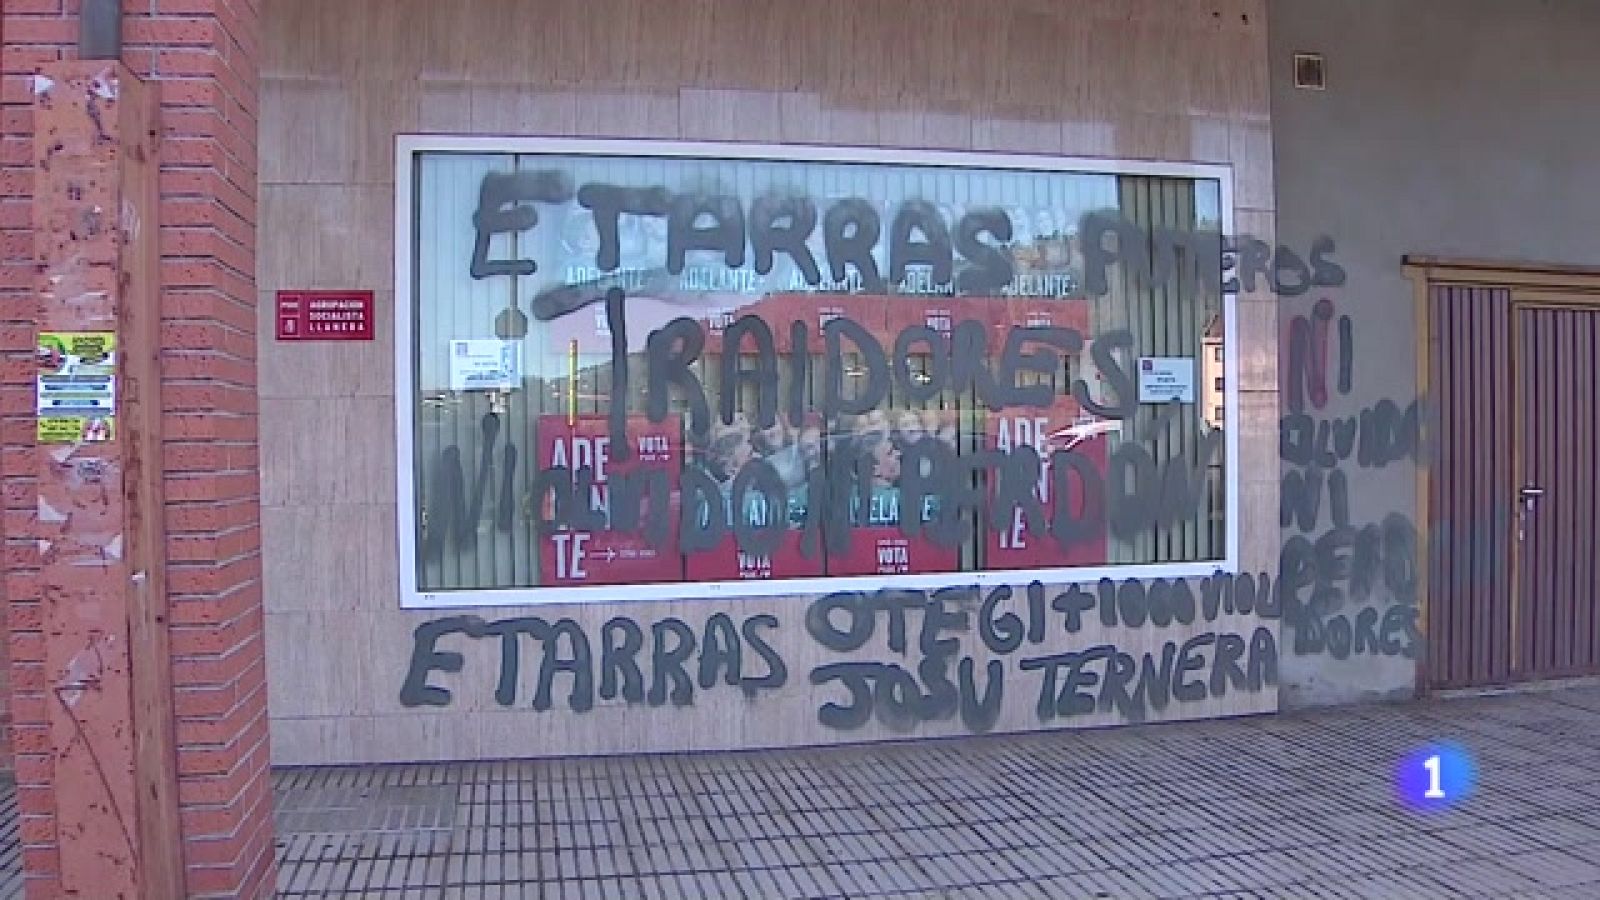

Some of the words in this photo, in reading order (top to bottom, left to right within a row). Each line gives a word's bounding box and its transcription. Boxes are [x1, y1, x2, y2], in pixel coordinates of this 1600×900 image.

[470, 168, 1013, 291] ETARRAS
[1002, 273, 1071, 296] DELANTE
[530, 283, 1136, 460] TRAIDORES
[551, 533, 592, 579] TE
[400, 612, 790, 713] ETARRAS
[804, 578, 1046, 657] OTEGI
[1019, 626, 1279, 723] TERNERA
